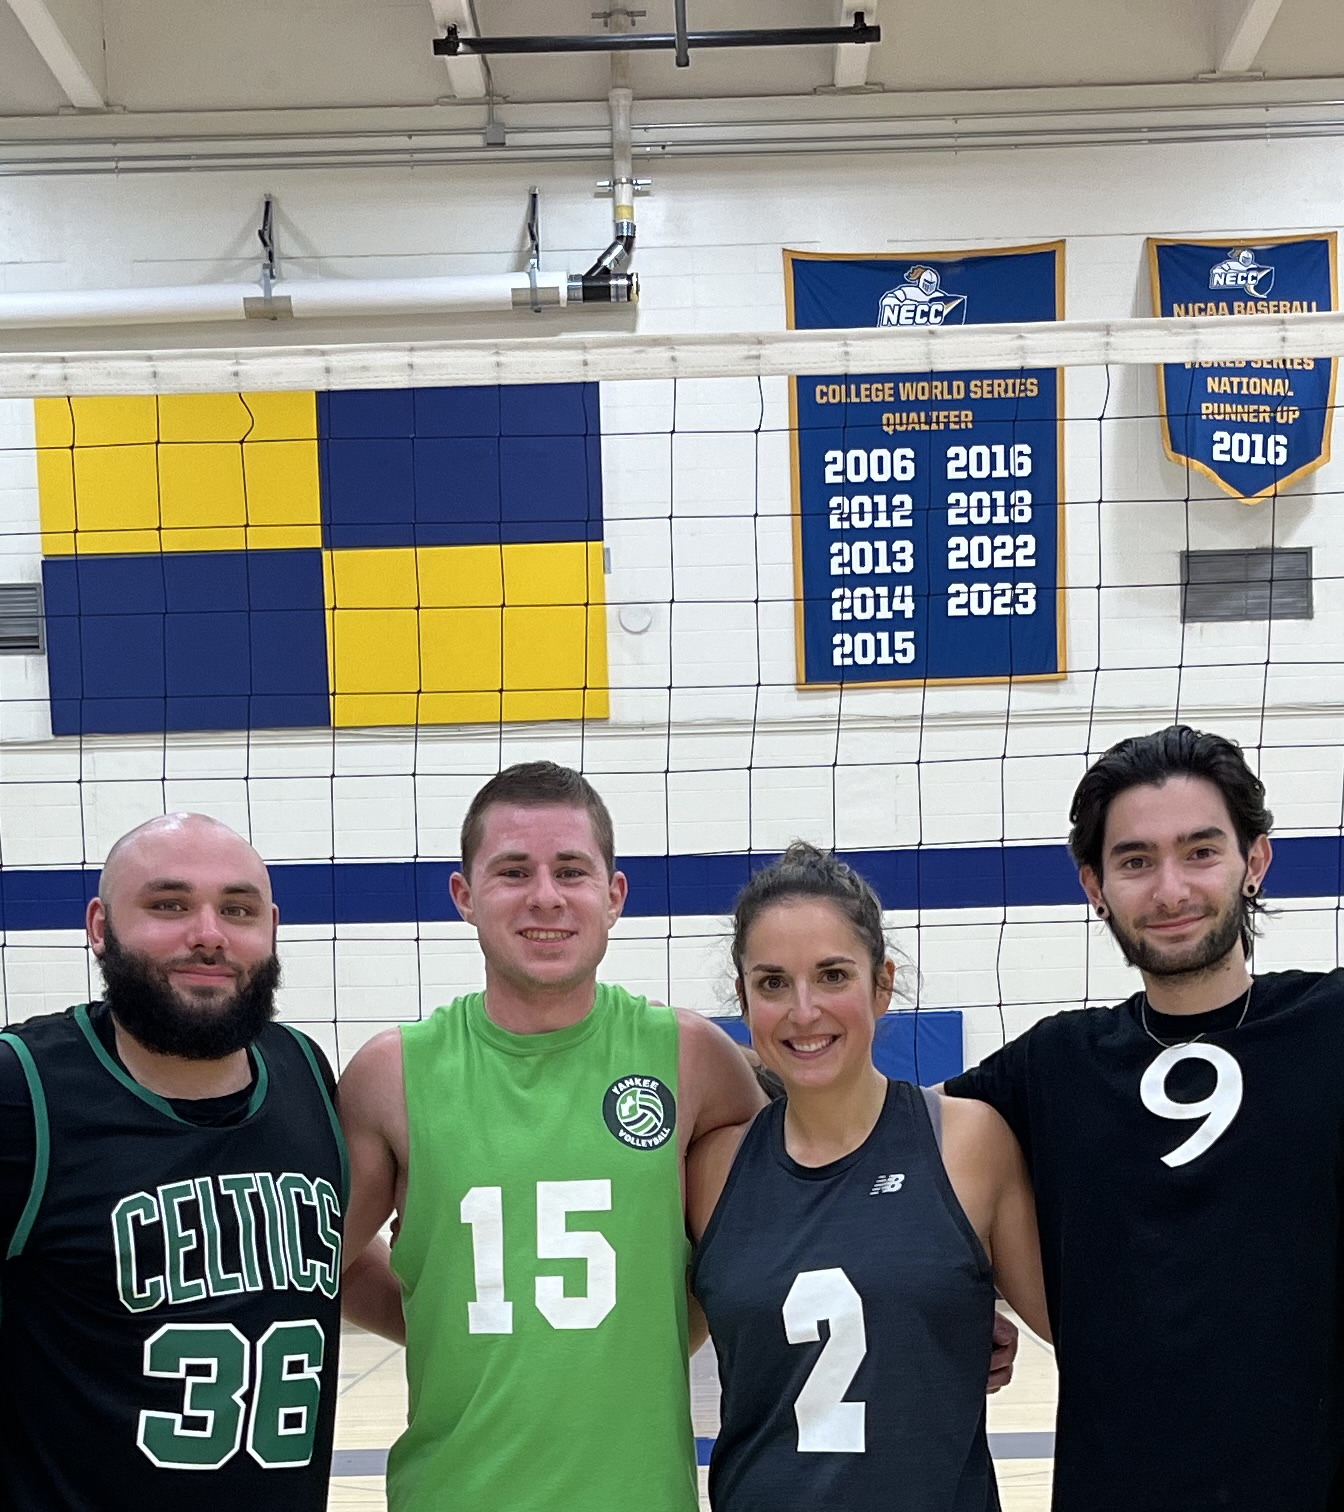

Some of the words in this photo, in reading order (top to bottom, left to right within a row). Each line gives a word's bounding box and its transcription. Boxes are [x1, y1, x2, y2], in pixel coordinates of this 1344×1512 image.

[1213, 272, 1258, 287] NECC
[882, 303, 945, 325] NECC
[1173, 302, 1229, 318] NJCAA
[815, 383, 895, 404] COLLEGE
[899, 380, 965, 401] WORLD
[969, 378, 1039, 399] SERIES
[1207, 376, 1294, 396] NATIONAL
[882, 410, 974, 435] QUALIFER
[824, 447, 915, 484] 2006
[946, 444, 1032, 480] 2016
[1212, 430, 1288, 466] 2016
[829, 494, 913, 529] 2012
[947, 489, 1032, 526] 2018
[830, 540, 914, 576] 2013
[947, 534, 1036, 570] 2022
[831, 585, 915, 621] 2014
[947, 582, 1037, 617] 2023
[832, 631, 915, 666] 2015
[611, 1077, 660, 1095] YANKEE
[1139, 1043, 1244, 1169] 9
[618, 1127, 671, 1148] VOLLEYBALL
[111, 1172, 342, 1313] CELTICS
[459, 1178, 616, 1334] 15
[782, 1267, 868, 1453] 2
[136, 1318, 325, 1470] 36
